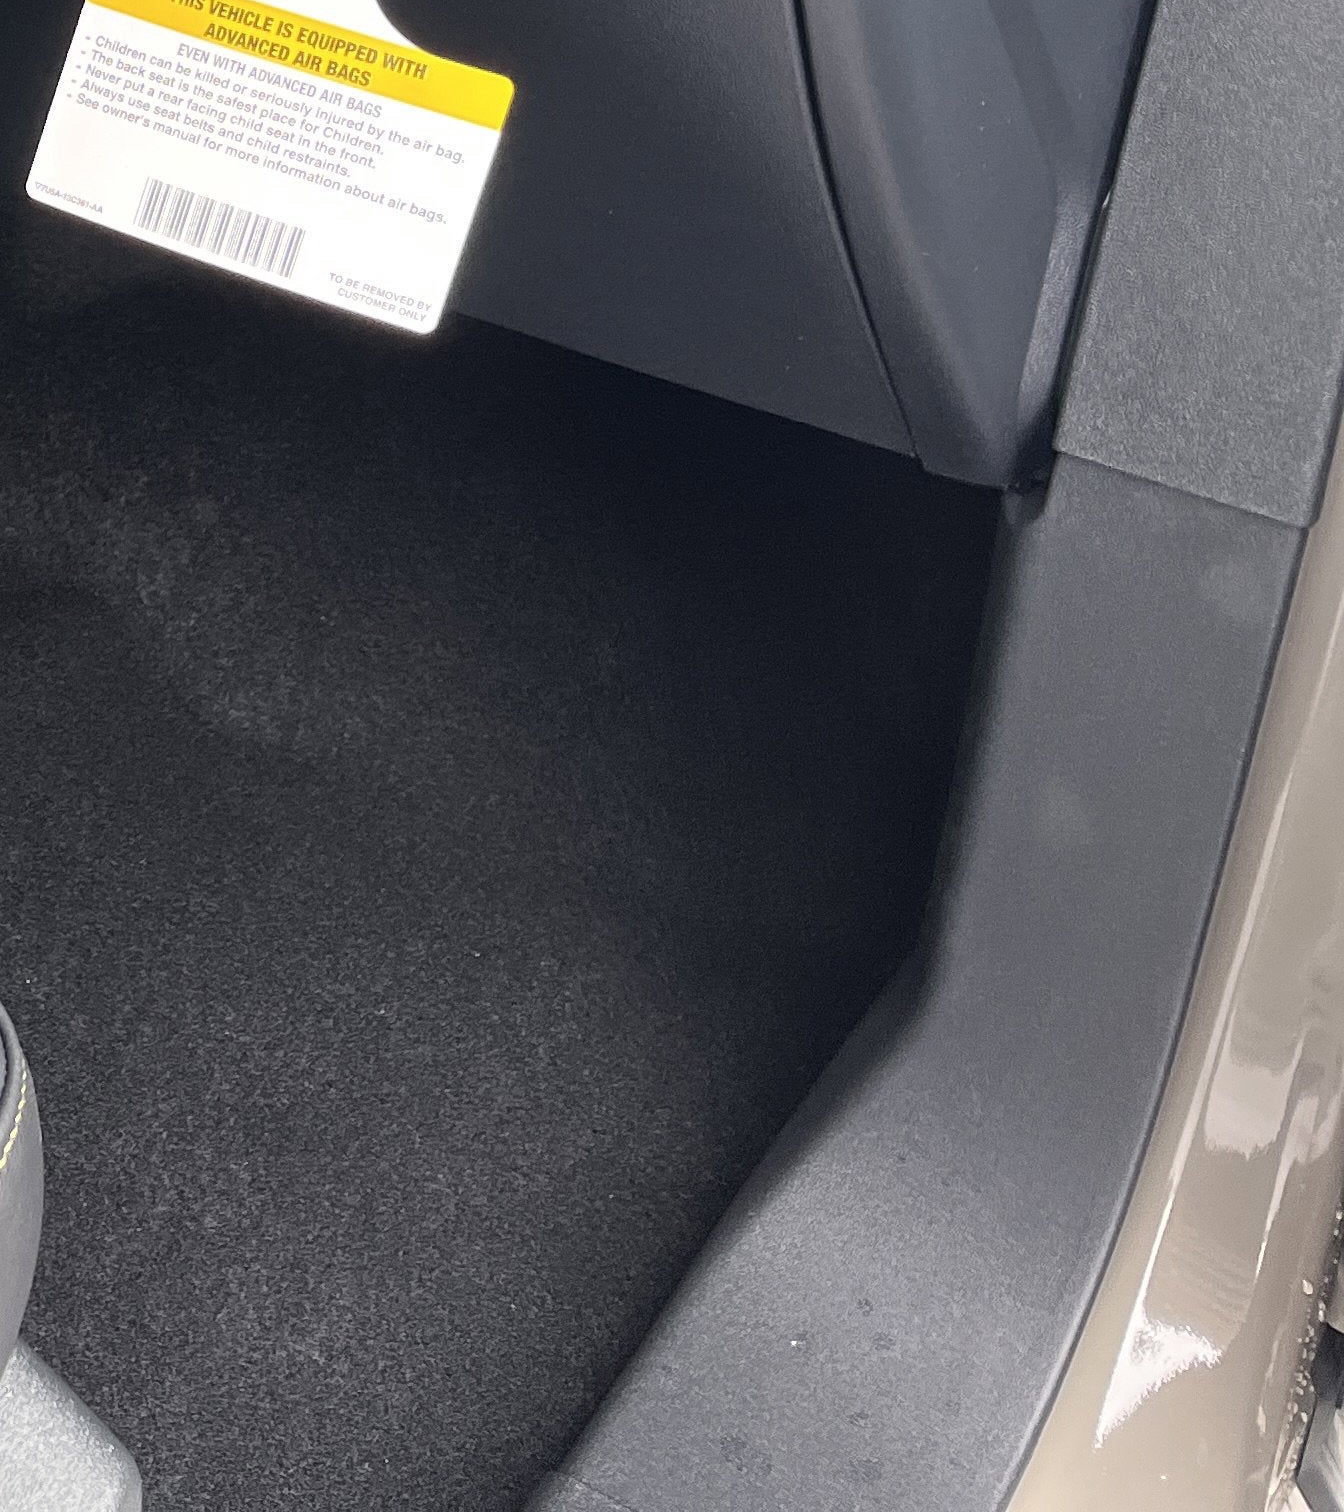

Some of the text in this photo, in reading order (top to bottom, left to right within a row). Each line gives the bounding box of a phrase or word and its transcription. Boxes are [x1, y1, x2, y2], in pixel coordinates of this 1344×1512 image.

[91, 48, 384, 156] The back seat is the safest place for Children.
[93, 35, 147, 62] Children
[149, 55, 173, 71] can
[174, 61, 192, 77] be
[194, 67, 231, 90] killed
[232, 83, 249, 95] or
[249, 89, 313, 118] seriously
[315, 106, 365, 132] injured
[366, 123, 386, 141] by
[387, 129, 411, 146] the
[412, 139, 433, 153] air
[176, 42, 383, 118] EVEN WITH ADVANCED AIR BAGS
[202, 22, 372, 87] ADVANCED AIR BAGS
[275, 20, 295, 39] IS
[295, 26, 378, 65] EQUIPPED
[382, 52, 428, 81] WITH
[75, 92, 100, 110] See
[101, 104, 151, 128] owner's
[152, 121, 202, 145] manual
[202, 136, 224, 152] for
[224, 145, 260, 165] more
[262, 155, 341, 191] information
[343, 184, 386, 205] about
[386, 198, 407, 211] air
[79, 78, 351, 178] Always use seat belts and child restraints.
[85, 63, 376, 170] Never put a rear facing child seat in the front.
